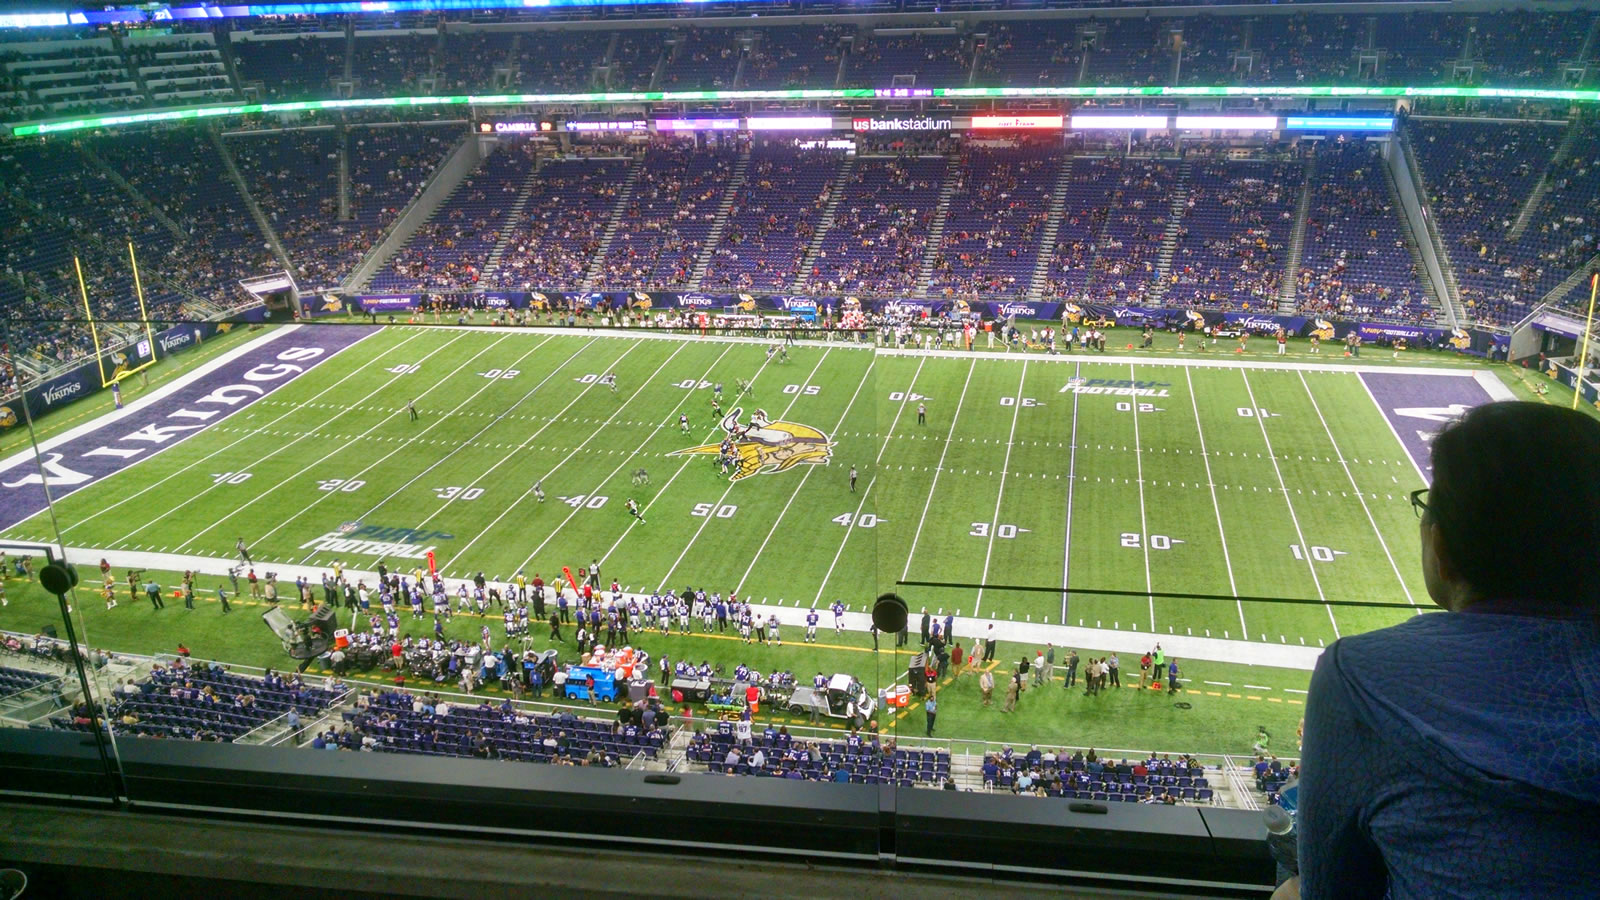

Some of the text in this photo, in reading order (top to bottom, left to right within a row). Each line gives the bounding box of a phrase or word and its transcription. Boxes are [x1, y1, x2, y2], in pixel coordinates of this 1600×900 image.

[677, 293, 712, 306] VIKINGS
[998, 302, 1036, 315] VIKINGS
[159, 333, 190, 352] VIKINGS
[42, 382, 81, 405] VIKINGS
[1059, 383, 1170, 397] FOOTBALL
[2, 346, 325, 488] VIKINGS
[213, 472, 252, 484] 10
[319, 479, 366, 492] 20
[437, 486, 485, 500] 30
[564, 495, 609, 509] 40
[691, 503, 738, 518] 50
[832, 512, 877, 528] 40
[970, 522, 1017, 539] 30
[298, 531, 437, 560] FOOTBALL
[1120, 533, 1172, 550] 20
[1289, 543, 1335, 562] 10
